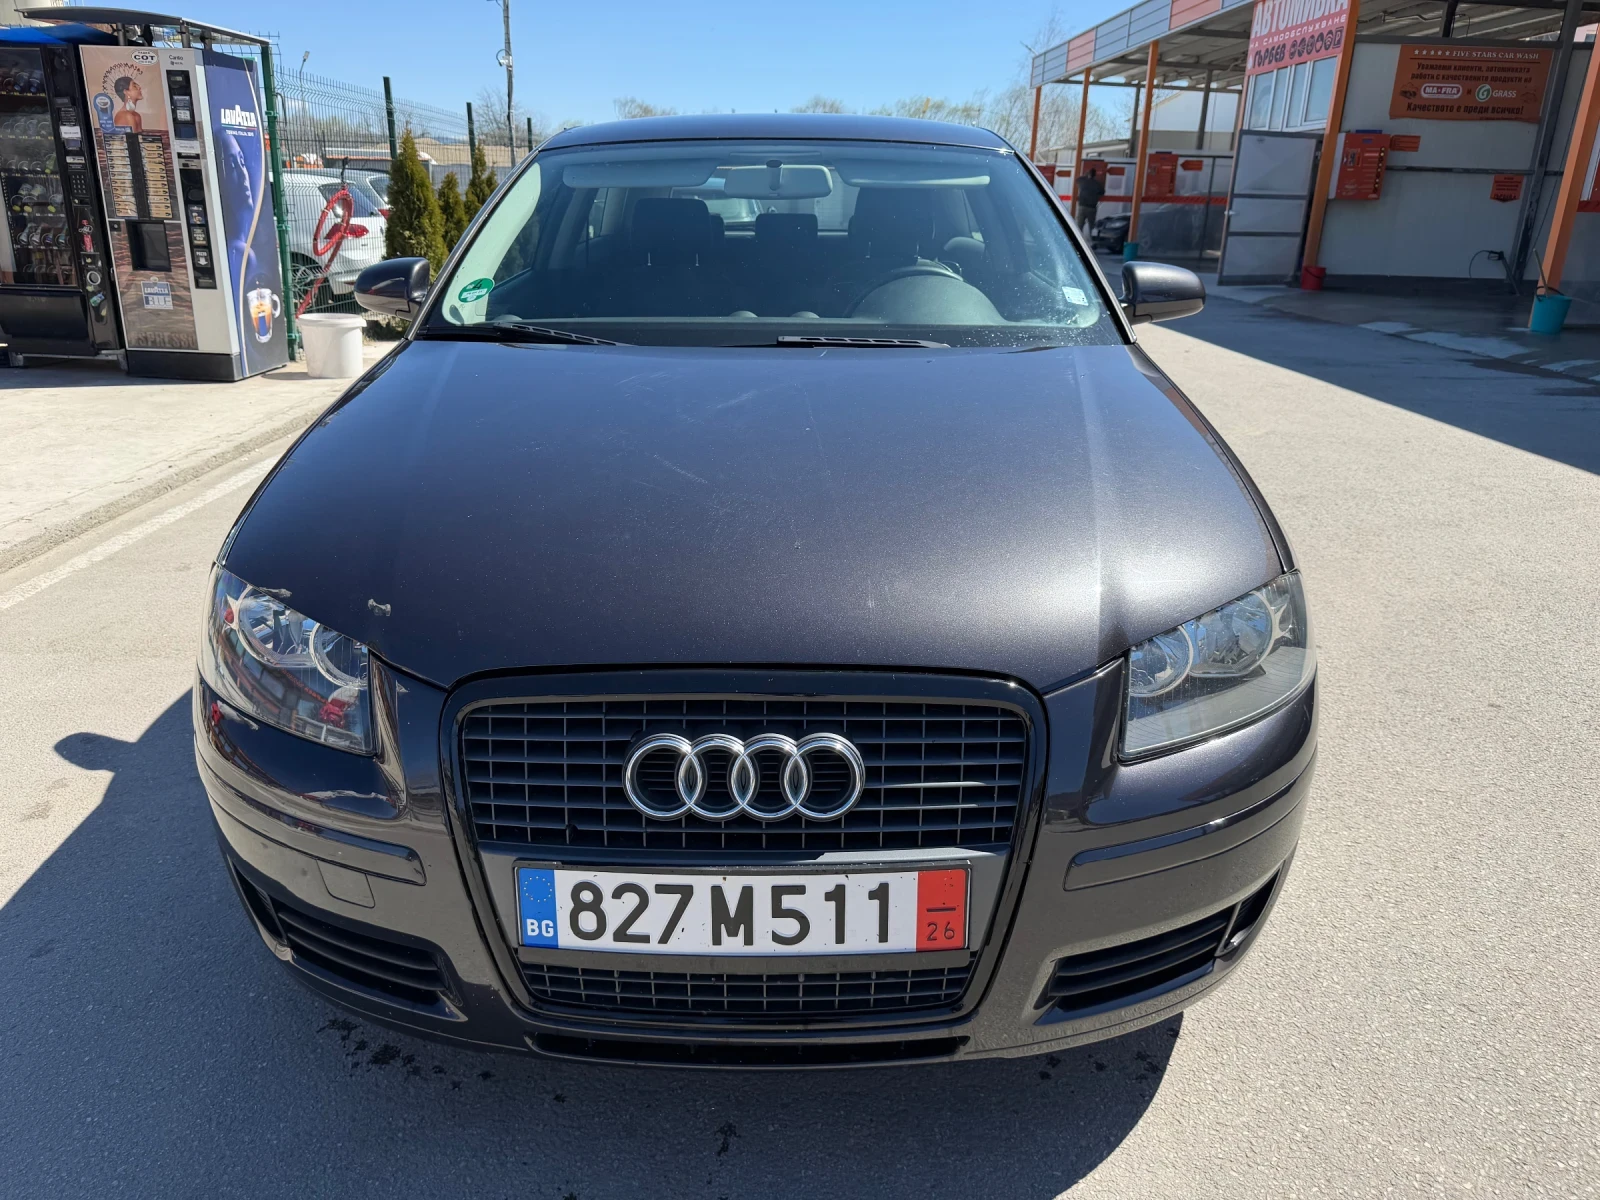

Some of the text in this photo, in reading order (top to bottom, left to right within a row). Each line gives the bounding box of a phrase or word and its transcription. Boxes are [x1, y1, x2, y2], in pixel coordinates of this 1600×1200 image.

[1251, 0, 1348, 38] АВТОМИВ
[1492, 90, 1517, 98] GRASS
[221, 104, 257, 127] LAVAZZA
[526, 918, 554, 937] BG
[926, 922, 955, 942] 26
